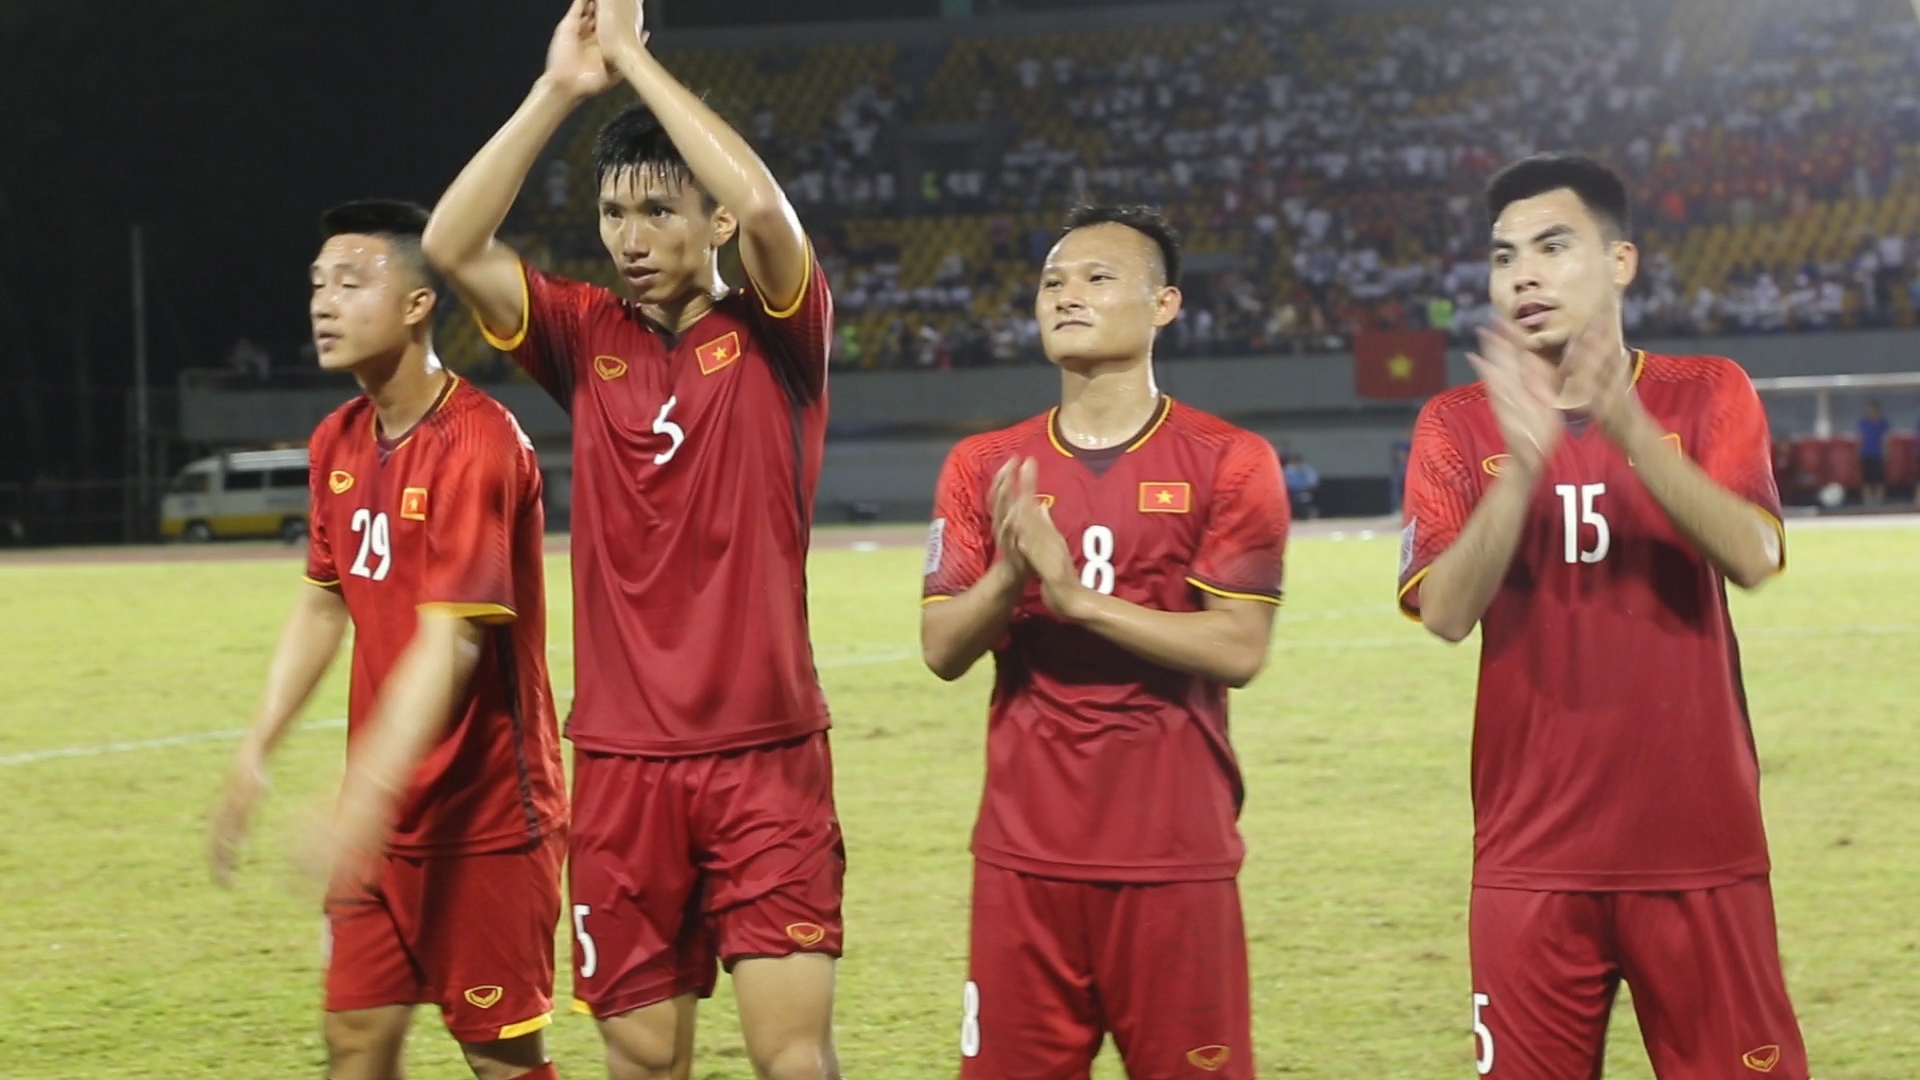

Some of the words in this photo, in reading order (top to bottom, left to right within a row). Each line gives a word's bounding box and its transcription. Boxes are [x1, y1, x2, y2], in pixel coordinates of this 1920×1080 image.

[652, 395, 685, 465] 5
[349, 508, 391, 581] 29
[1555, 482, 1610, 563] 15
[1081, 524, 1115, 595] 8
[573, 904, 597, 978] 5
[961, 980, 980, 1057] 8
